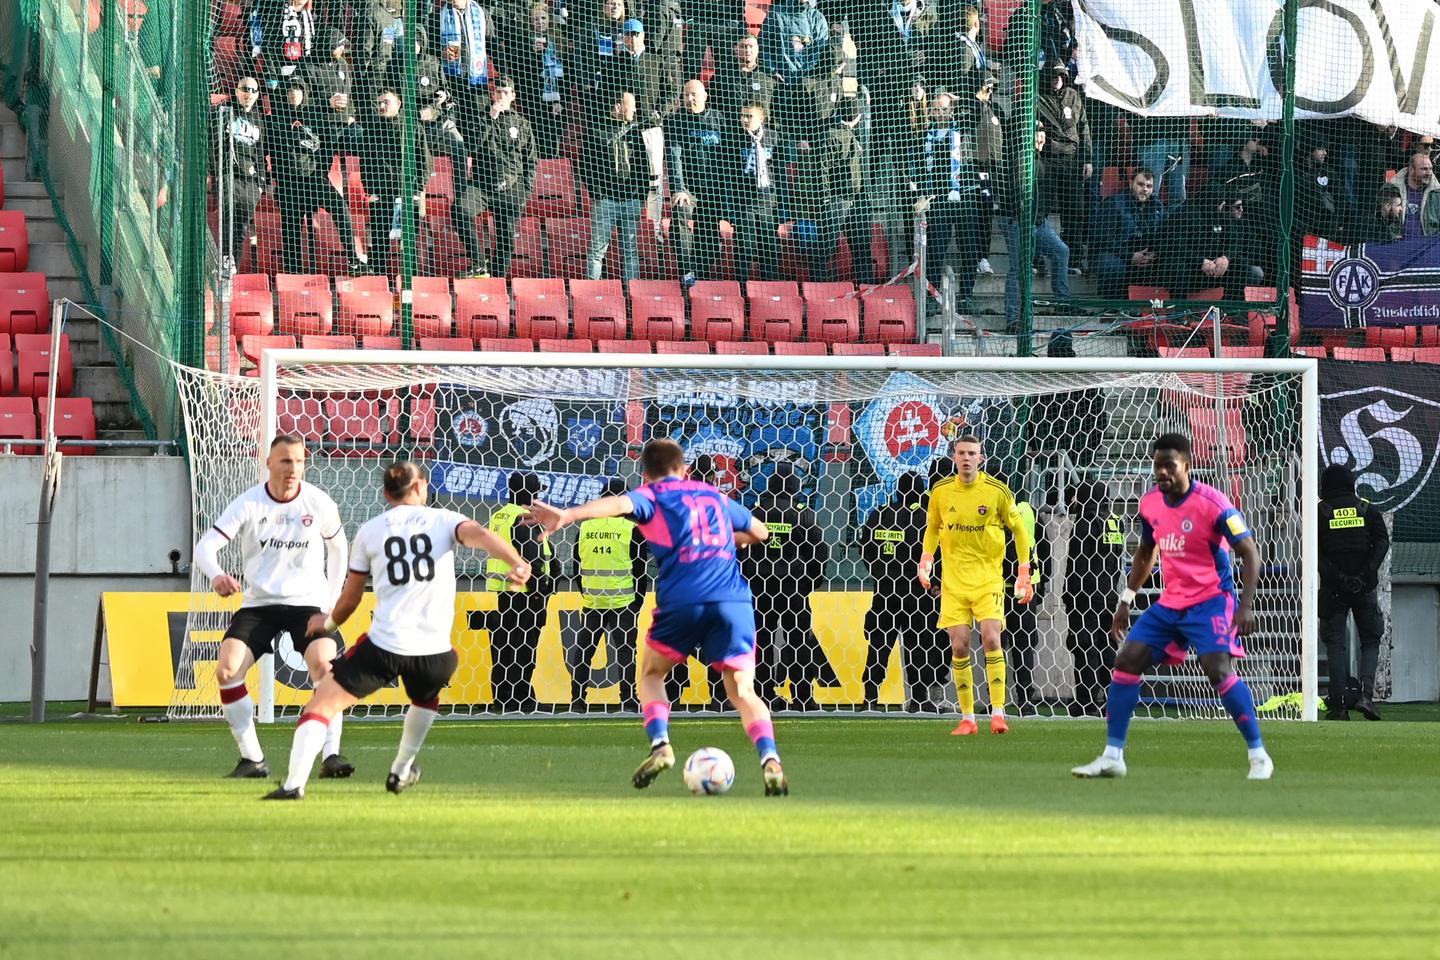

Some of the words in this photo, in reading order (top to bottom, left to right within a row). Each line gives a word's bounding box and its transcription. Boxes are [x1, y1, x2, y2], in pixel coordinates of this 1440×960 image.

[1334, 508, 1356, 518] 403
[681, 494, 726, 547] 10
[1330, 519, 1364, 528] SECURITY
[955, 522, 985, 533] Tipsport
[586, 531, 622, 540] SECURITY
[269, 538, 310, 550] Tipsport
[592, 546, 612, 555] 414
[383, 532, 436, 586] 88
[1210, 615, 1227, 635] 15
